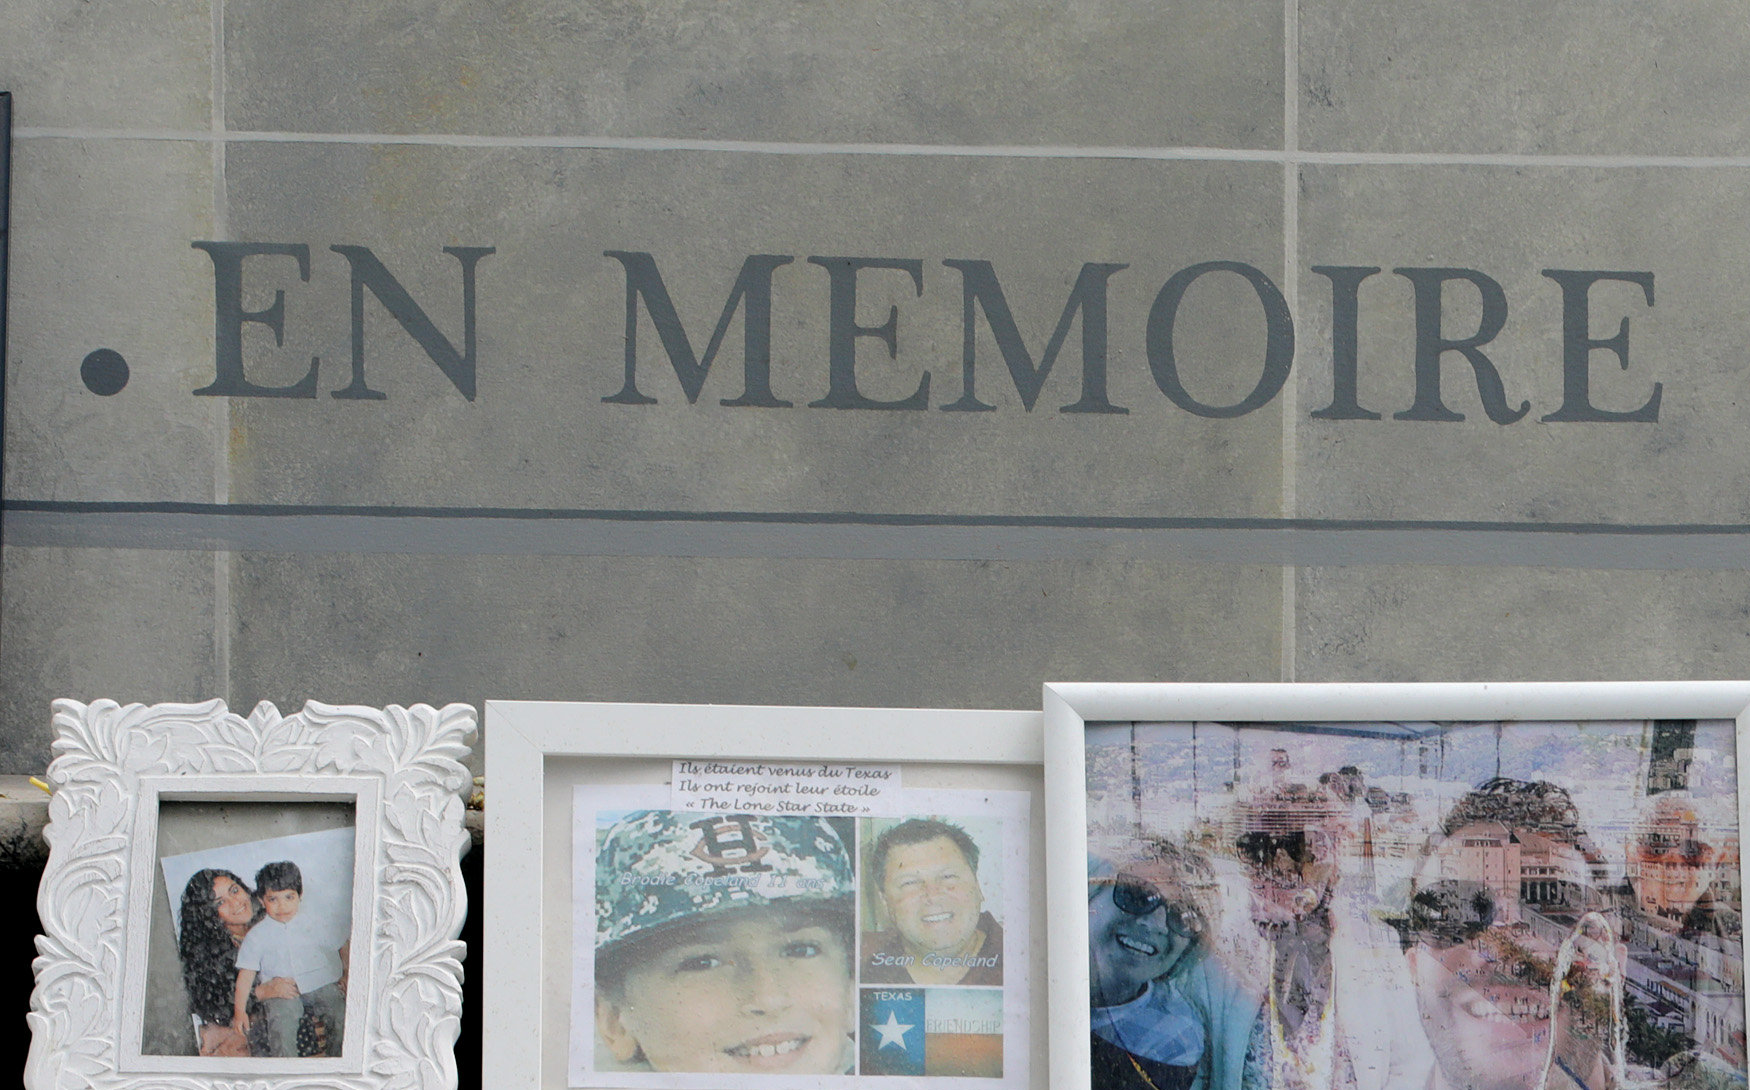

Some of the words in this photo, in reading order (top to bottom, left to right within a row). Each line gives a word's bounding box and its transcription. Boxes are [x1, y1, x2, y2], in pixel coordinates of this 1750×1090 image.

[191, 240, 497, 402] EN
[601, 249, 1664, 426] MEMOIRE
[679, 762, 700, 775] Ils
[704, 762, 764, 776] étaient
[768, 766, 816, 777] venus
[818, 763, 843, 778] du
[846, 766, 892, 780] Texas
[679, 780, 700, 792] Ils
[704, 782, 733, 793] ont
[736, 781, 792, 796] rejoint
[795, 781, 829, 795] leur
[833, 783, 882, 797] étoile
[699, 797, 731, 811] The
[734, 798, 774, 812] Lone
[776, 801, 811, 813] Star
[815, 801, 858, 814] State
[620, 871, 676, 887] Brodie
[684, 872, 761, 891] Copeland
[766, 873, 789, 888] 11
[795, 878, 825, 890] ans
[872, 951, 915, 967] Sean
[922, 952, 999, 971] Copeland
[872, 991, 913, 1002] TEXAS
[926, 1018, 1001, 1035] FRIENDSHIP
